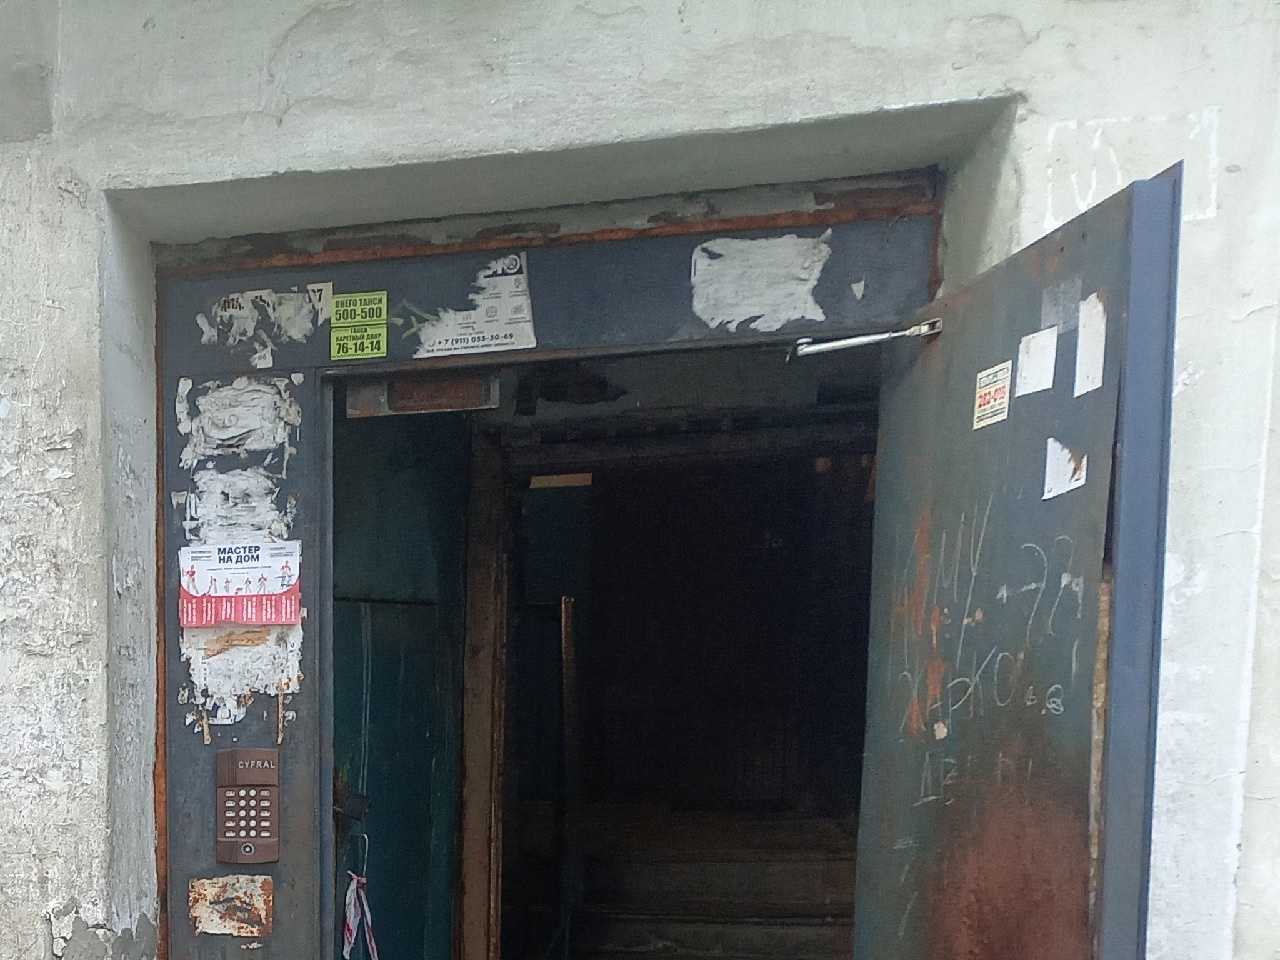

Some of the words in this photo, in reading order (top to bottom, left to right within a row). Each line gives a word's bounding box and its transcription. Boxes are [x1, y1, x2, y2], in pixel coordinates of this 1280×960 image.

[335, 307, 382, 321] 500-500
[336, 340, 381, 354] 76-14-14
[217, 545, 261, 555] МАСТЕР
[218, 555, 234, 564] НА
[235, 554, 260, 564] ДОМ
[238, 760, 276, 769] CYFRAL
